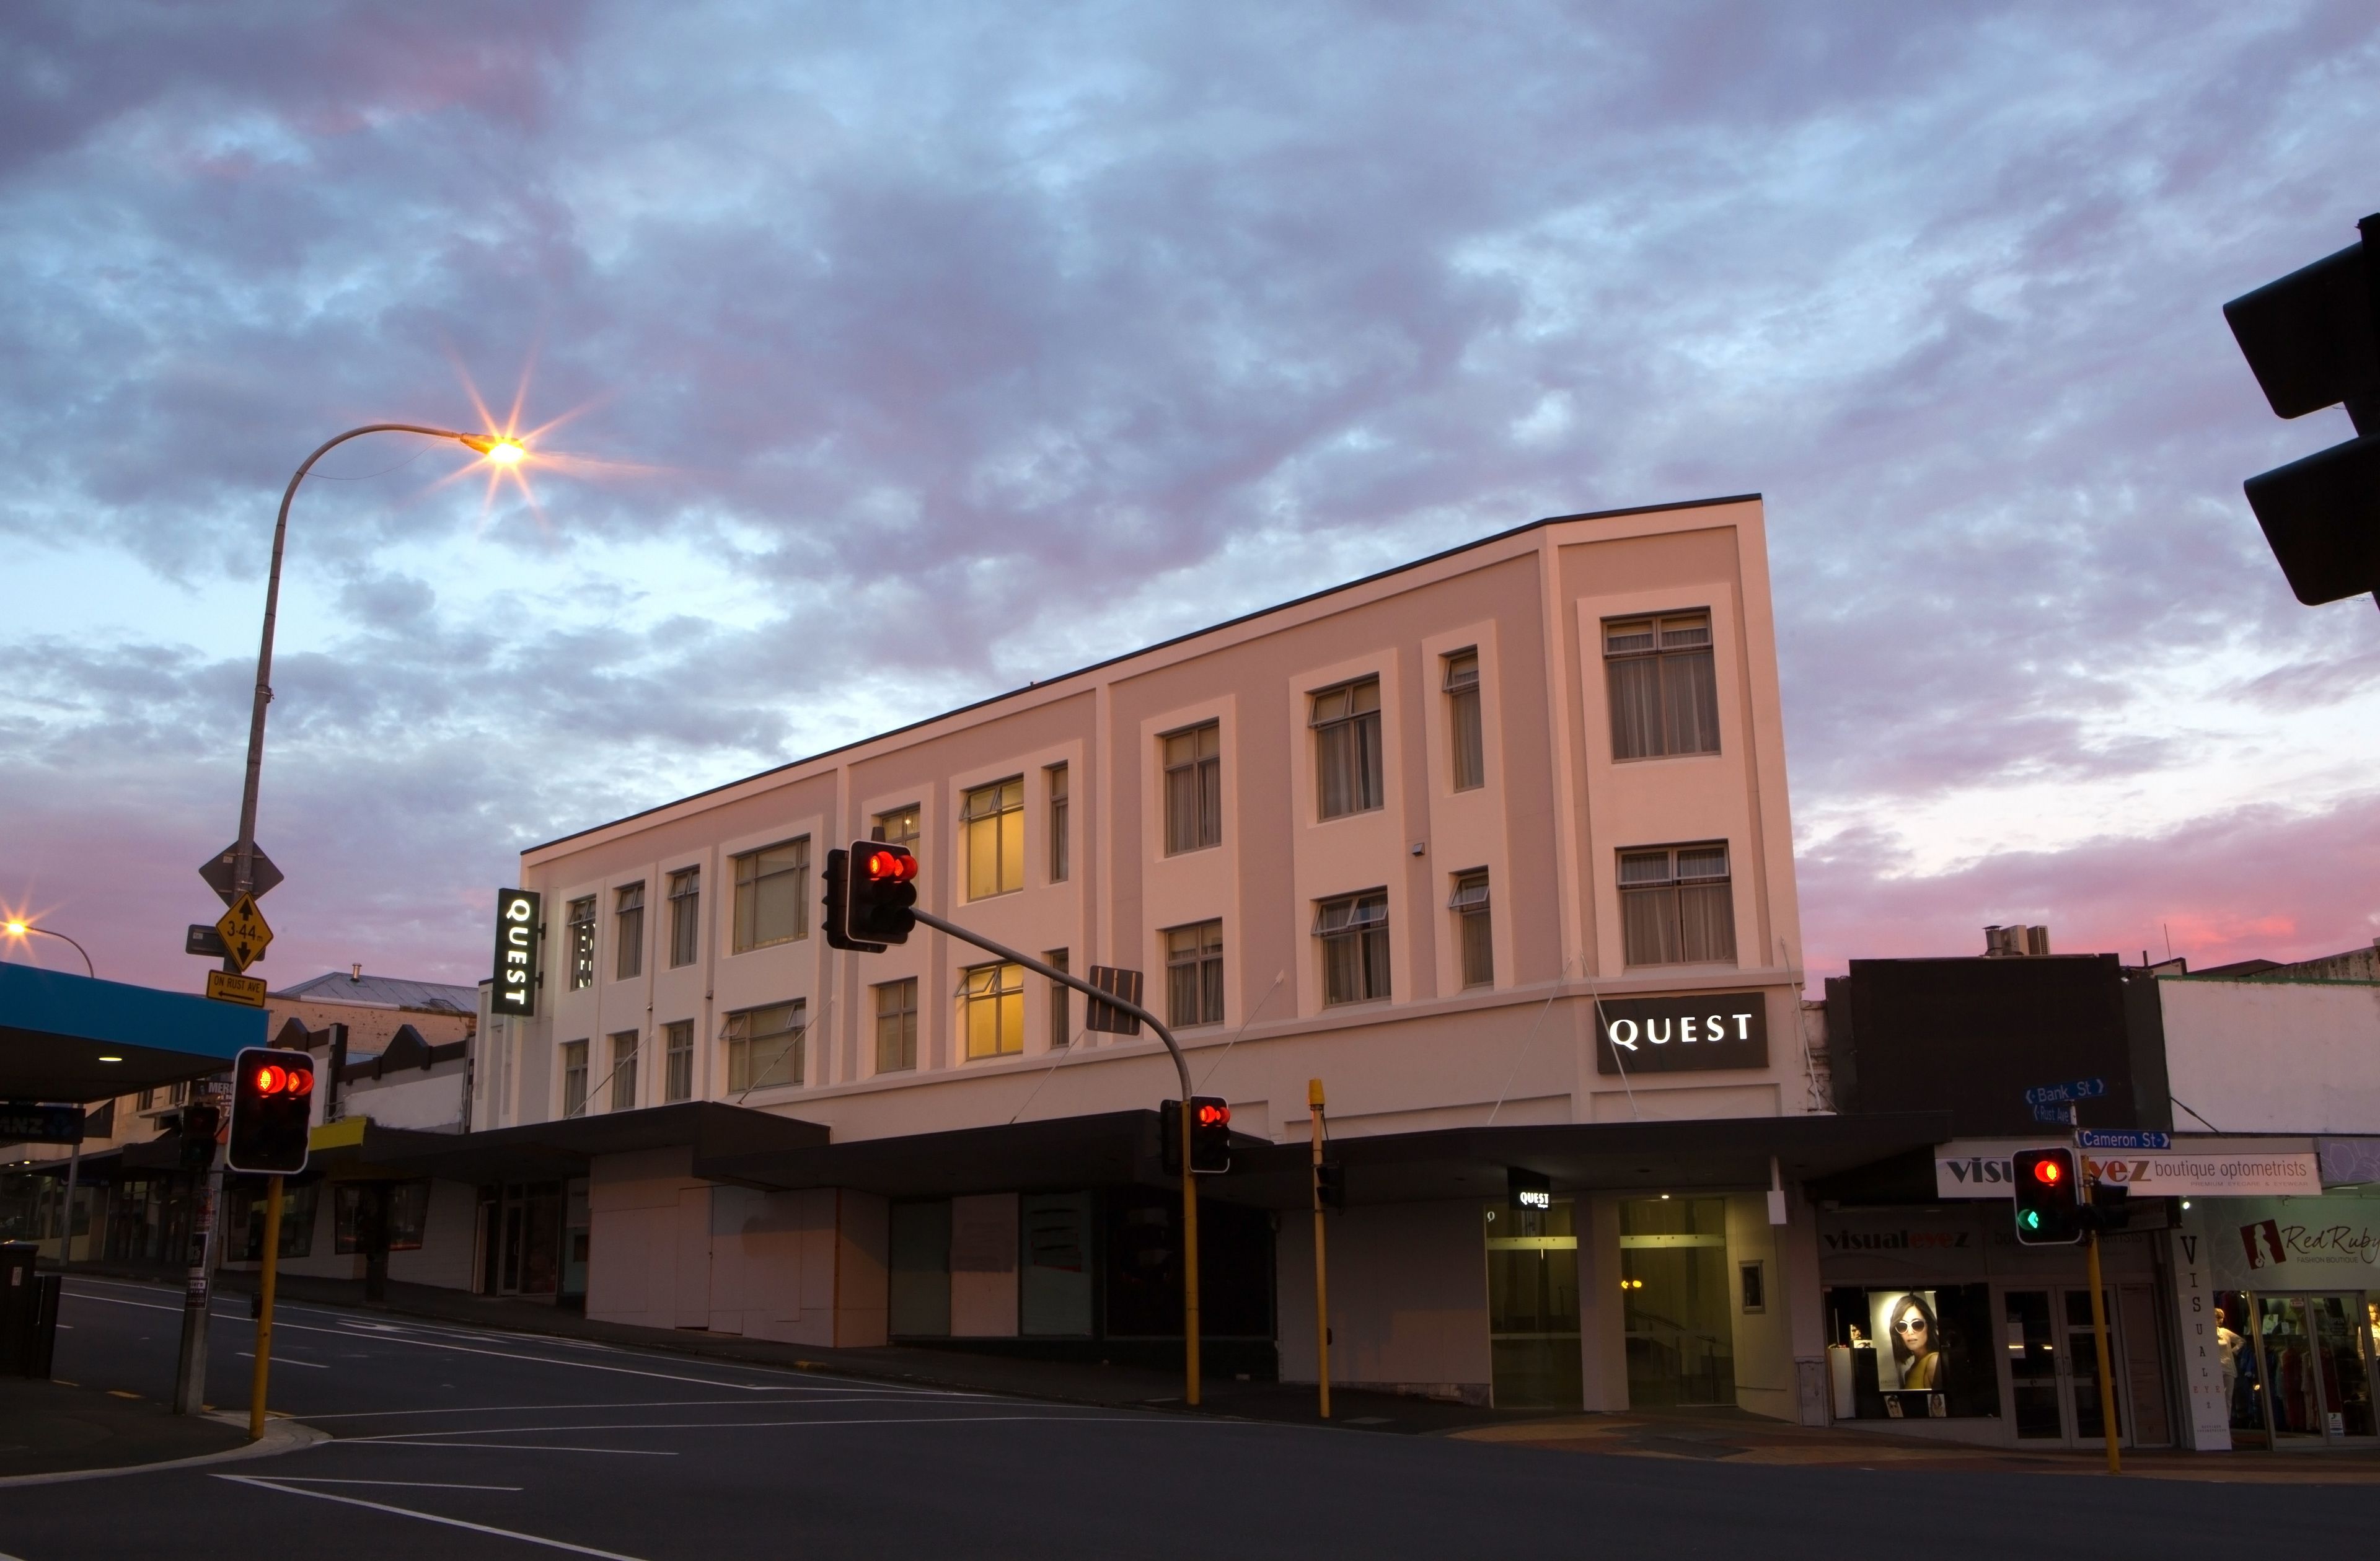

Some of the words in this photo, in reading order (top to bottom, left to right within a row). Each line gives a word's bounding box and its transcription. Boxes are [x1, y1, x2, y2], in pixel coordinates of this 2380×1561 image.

[506, 899, 531, 1005] QUEST
[214, 975, 224, 986] ON
[227, 978, 245, 990] RUST
[248, 983, 261, 993] AVE
[1610, 1014, 1752, 1051] QUEST
[2037, 1085, 2069, 1102] Bank
[2077, 1081, 2092, 1096] St
[2040, 1106, 2056, 1121] Rust
[2057, 1109, 2069, 1122] Ave
[2082, 1130, 2137, 1146] Cameron
[2142, 1132, 2157, 1147] St
[2154, 1161, 2215, 1179] boutique
[2220, 1160, 2307, 1180] optometrists
[1520, 1192, 1549, 1205] QUEST
[1823, 1229, 1971, 1249] visualeyez
